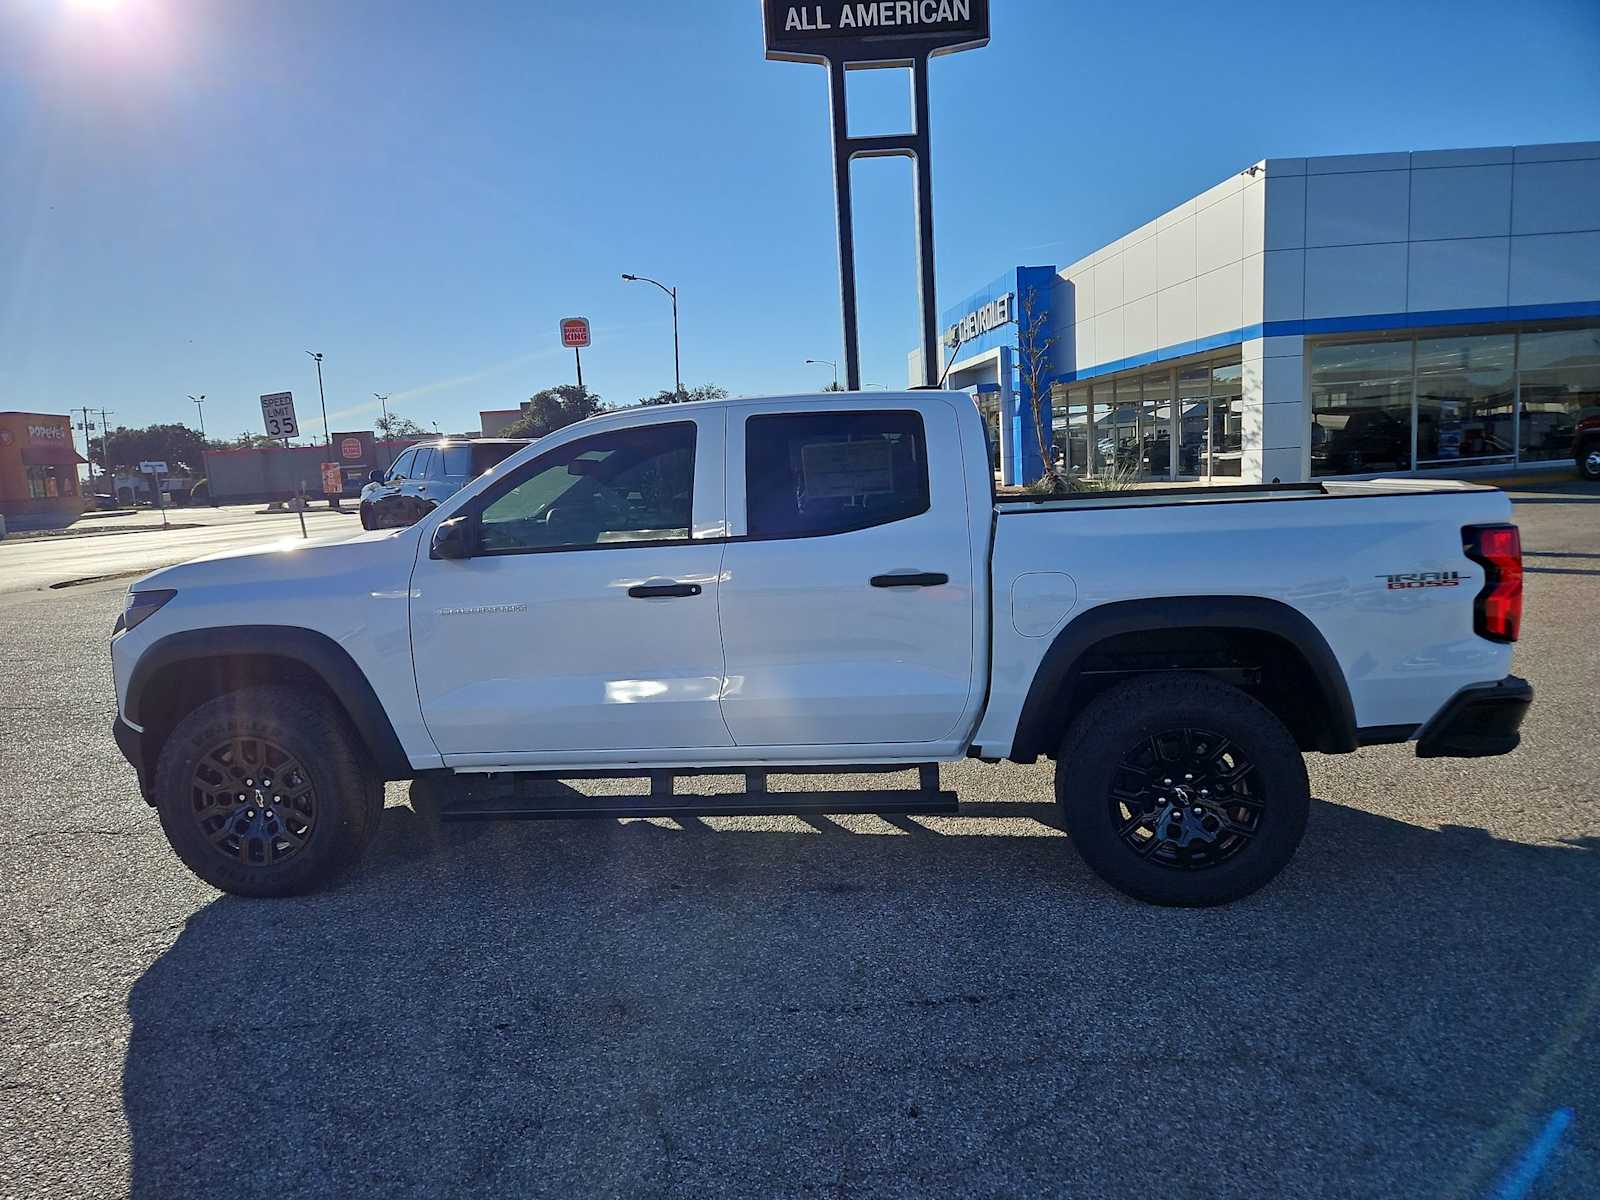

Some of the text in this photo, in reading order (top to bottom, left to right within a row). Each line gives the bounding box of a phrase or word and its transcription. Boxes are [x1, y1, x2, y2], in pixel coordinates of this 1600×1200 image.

[785, 0, 970, 31] ALL AMERICAN
[959, 291, 1014, 343] CHEVROLET
[564, 333, 587, 341] KING
[263, 396, 291, 408] SPEED
[267, 407, 289, 418] LIMIT
[269, 417, 294, 436] 35
[1375, 571, 1471, 582] TRAIL
[1387, 580, 1459, 590] BOSS
